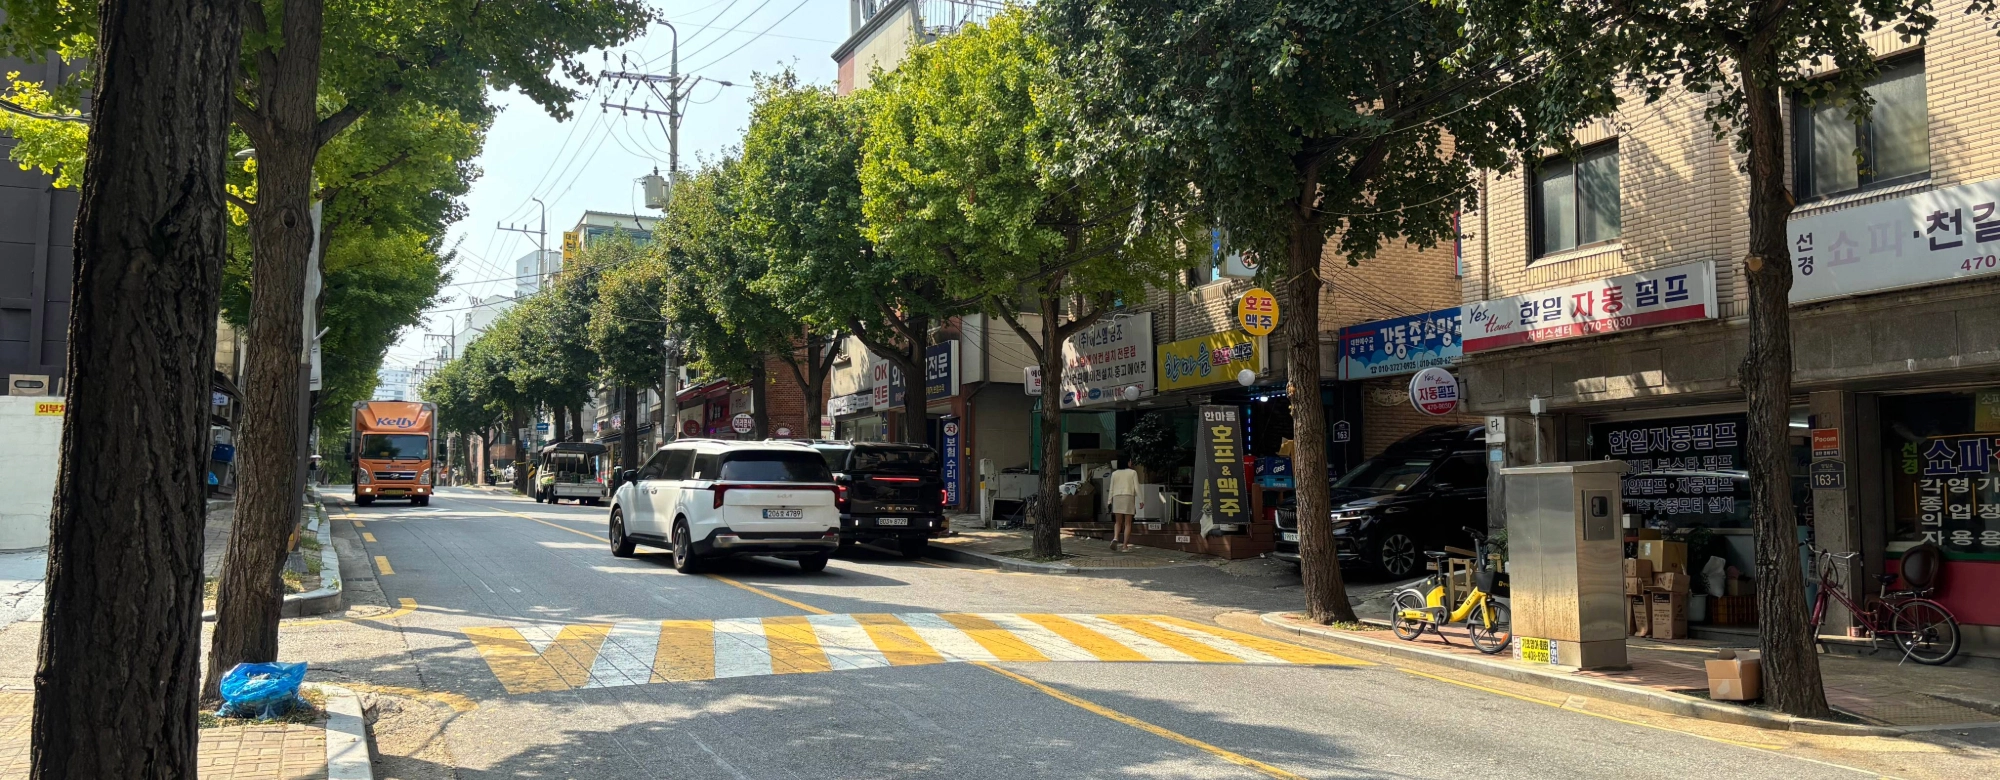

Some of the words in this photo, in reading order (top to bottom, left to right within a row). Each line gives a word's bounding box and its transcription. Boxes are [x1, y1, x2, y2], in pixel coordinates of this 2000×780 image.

[1961, 254, 2000, 271] 470
[1245, 296, 1272, 312] 호프
[1520, 296, 1562, 326] 한일
[1245, 313, 1272, 330] 맥주
[1526, 324, 1572, 341] 서비스센터
[1583, 316, 1632, 333] 470-9030
[926, 352, 948, 380] 전문
[1165, 342, 1211, 382] 한마음
[874, 363, 888, 382] OK
[1418, 385, 1456, 400] 자동펌프
[376, 418, 416, 428] Kelly
[1204, 411, 1236, 422] 한마음
[1490, 418, 1500, 430] 다
[1609, 422, 1738, 455] 한일자동펌프
[946, 438, 956, 458] 보험
[1703, 454, 1733, 472] 펌프
[1902, 441, 1918, 474] 선경
[946, 460, 956, 480] 수리
[1814, 474, 1840, 486] 163-1
[786, 510, 800, 518] 4789
